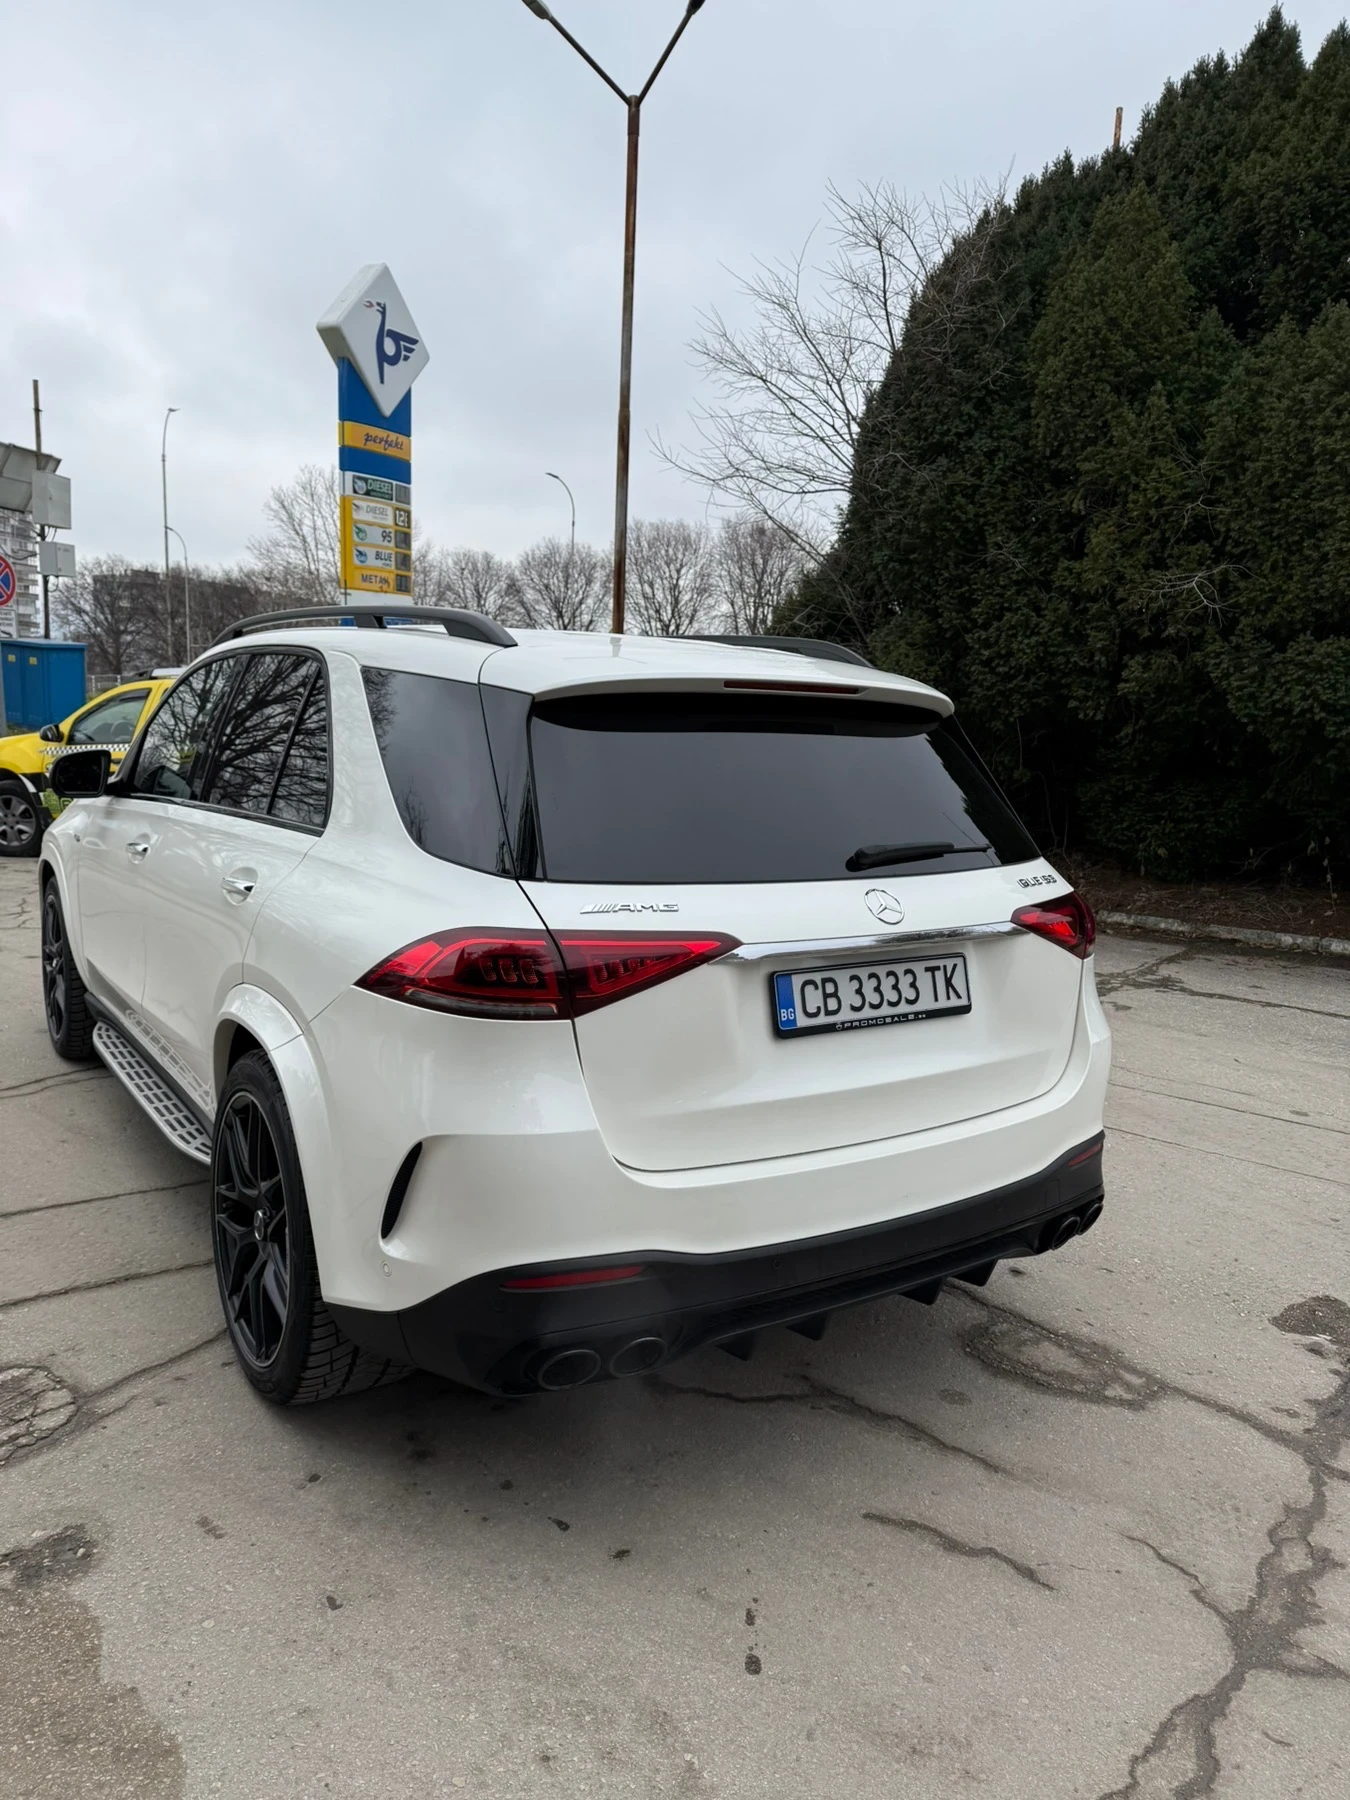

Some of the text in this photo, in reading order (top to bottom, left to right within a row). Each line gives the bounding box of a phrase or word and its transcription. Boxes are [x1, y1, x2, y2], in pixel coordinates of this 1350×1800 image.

[367, 479, 392, 494] DIESEL
[366, 504, 389, 517] DIESEL
[381, 530, 392, 544] 95
[375, 550, 393, 562] BLUE
[1017, 876, 1043, 888] GLE
[612, 902, 679, 913] AMG
[799, 963, 963, 1019] CB 3333 TK
[780, 1008, 795, 1021] BG
